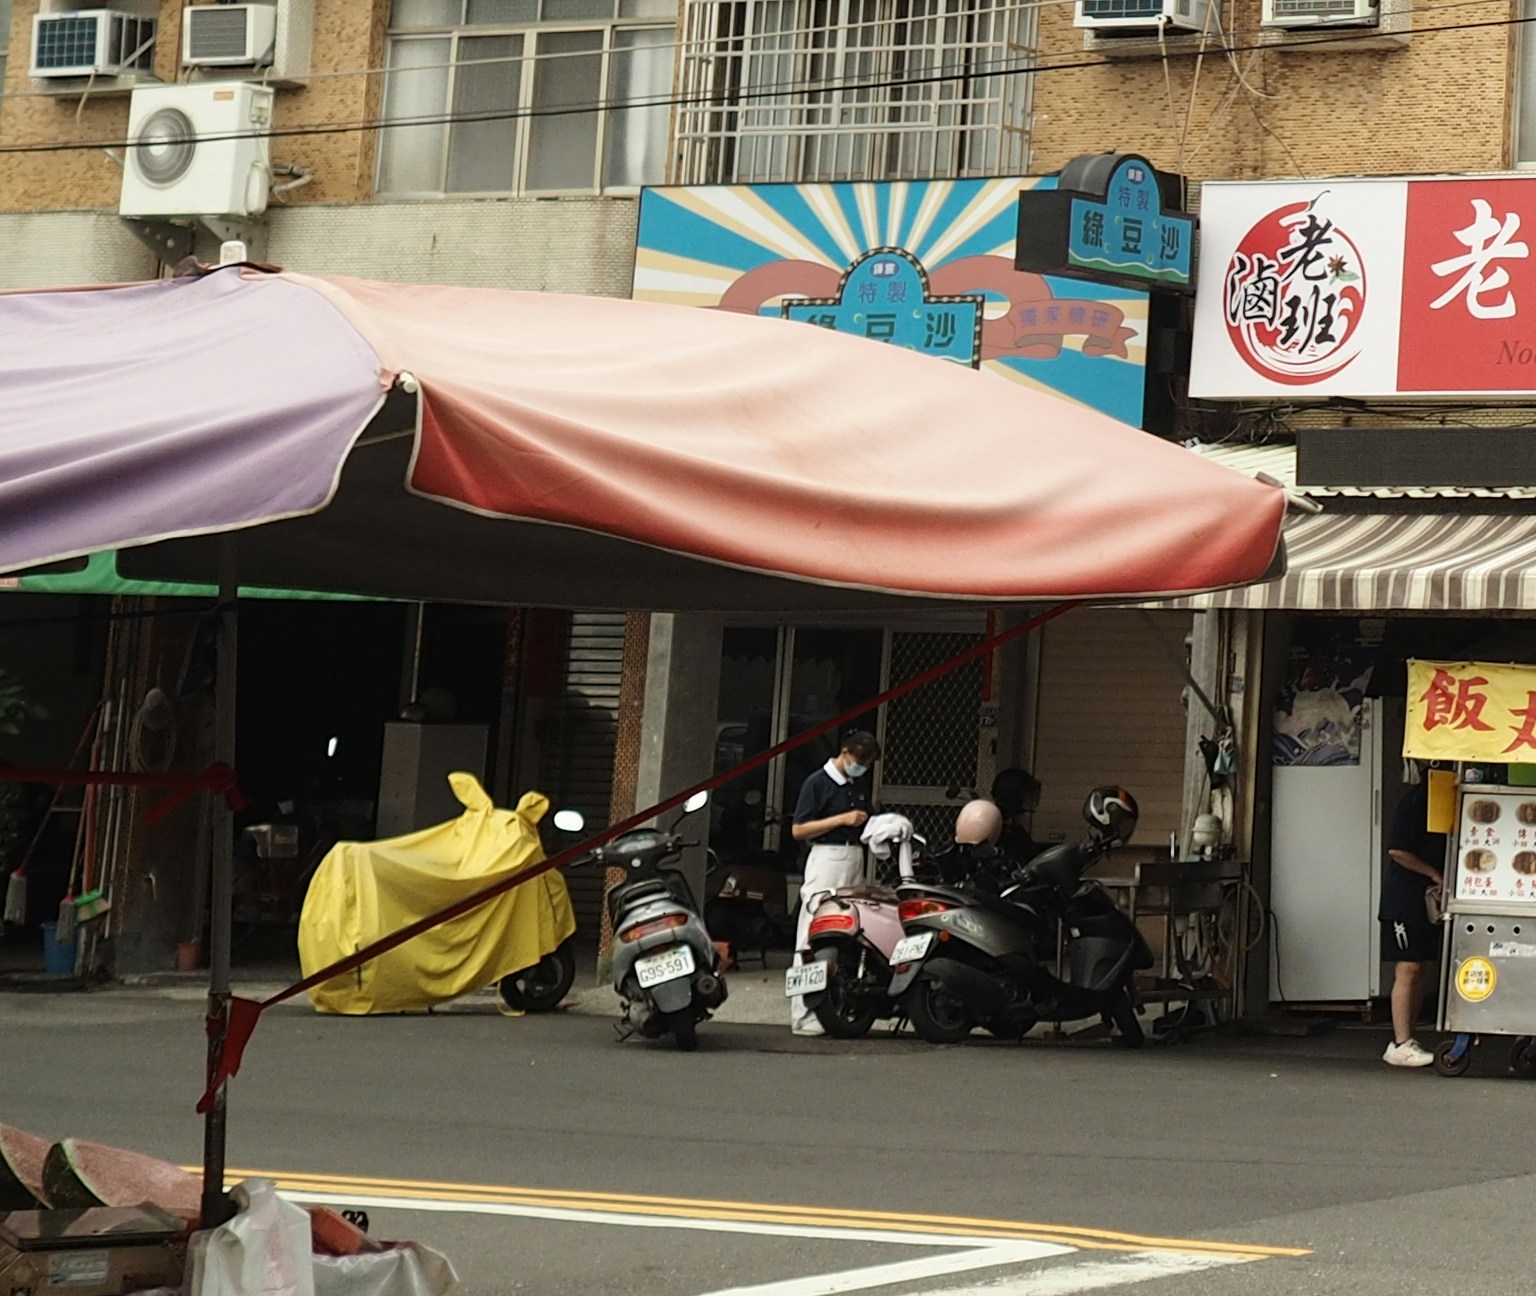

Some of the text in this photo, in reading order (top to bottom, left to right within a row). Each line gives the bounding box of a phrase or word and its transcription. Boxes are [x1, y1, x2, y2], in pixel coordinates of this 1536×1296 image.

[1118, 186, 1150, 211] 特製
[1083, 209, 1180, 261] 綠豆沙
[858, 281, 907, 305] 特製
[639, 957, 690, 983] G9S-591
